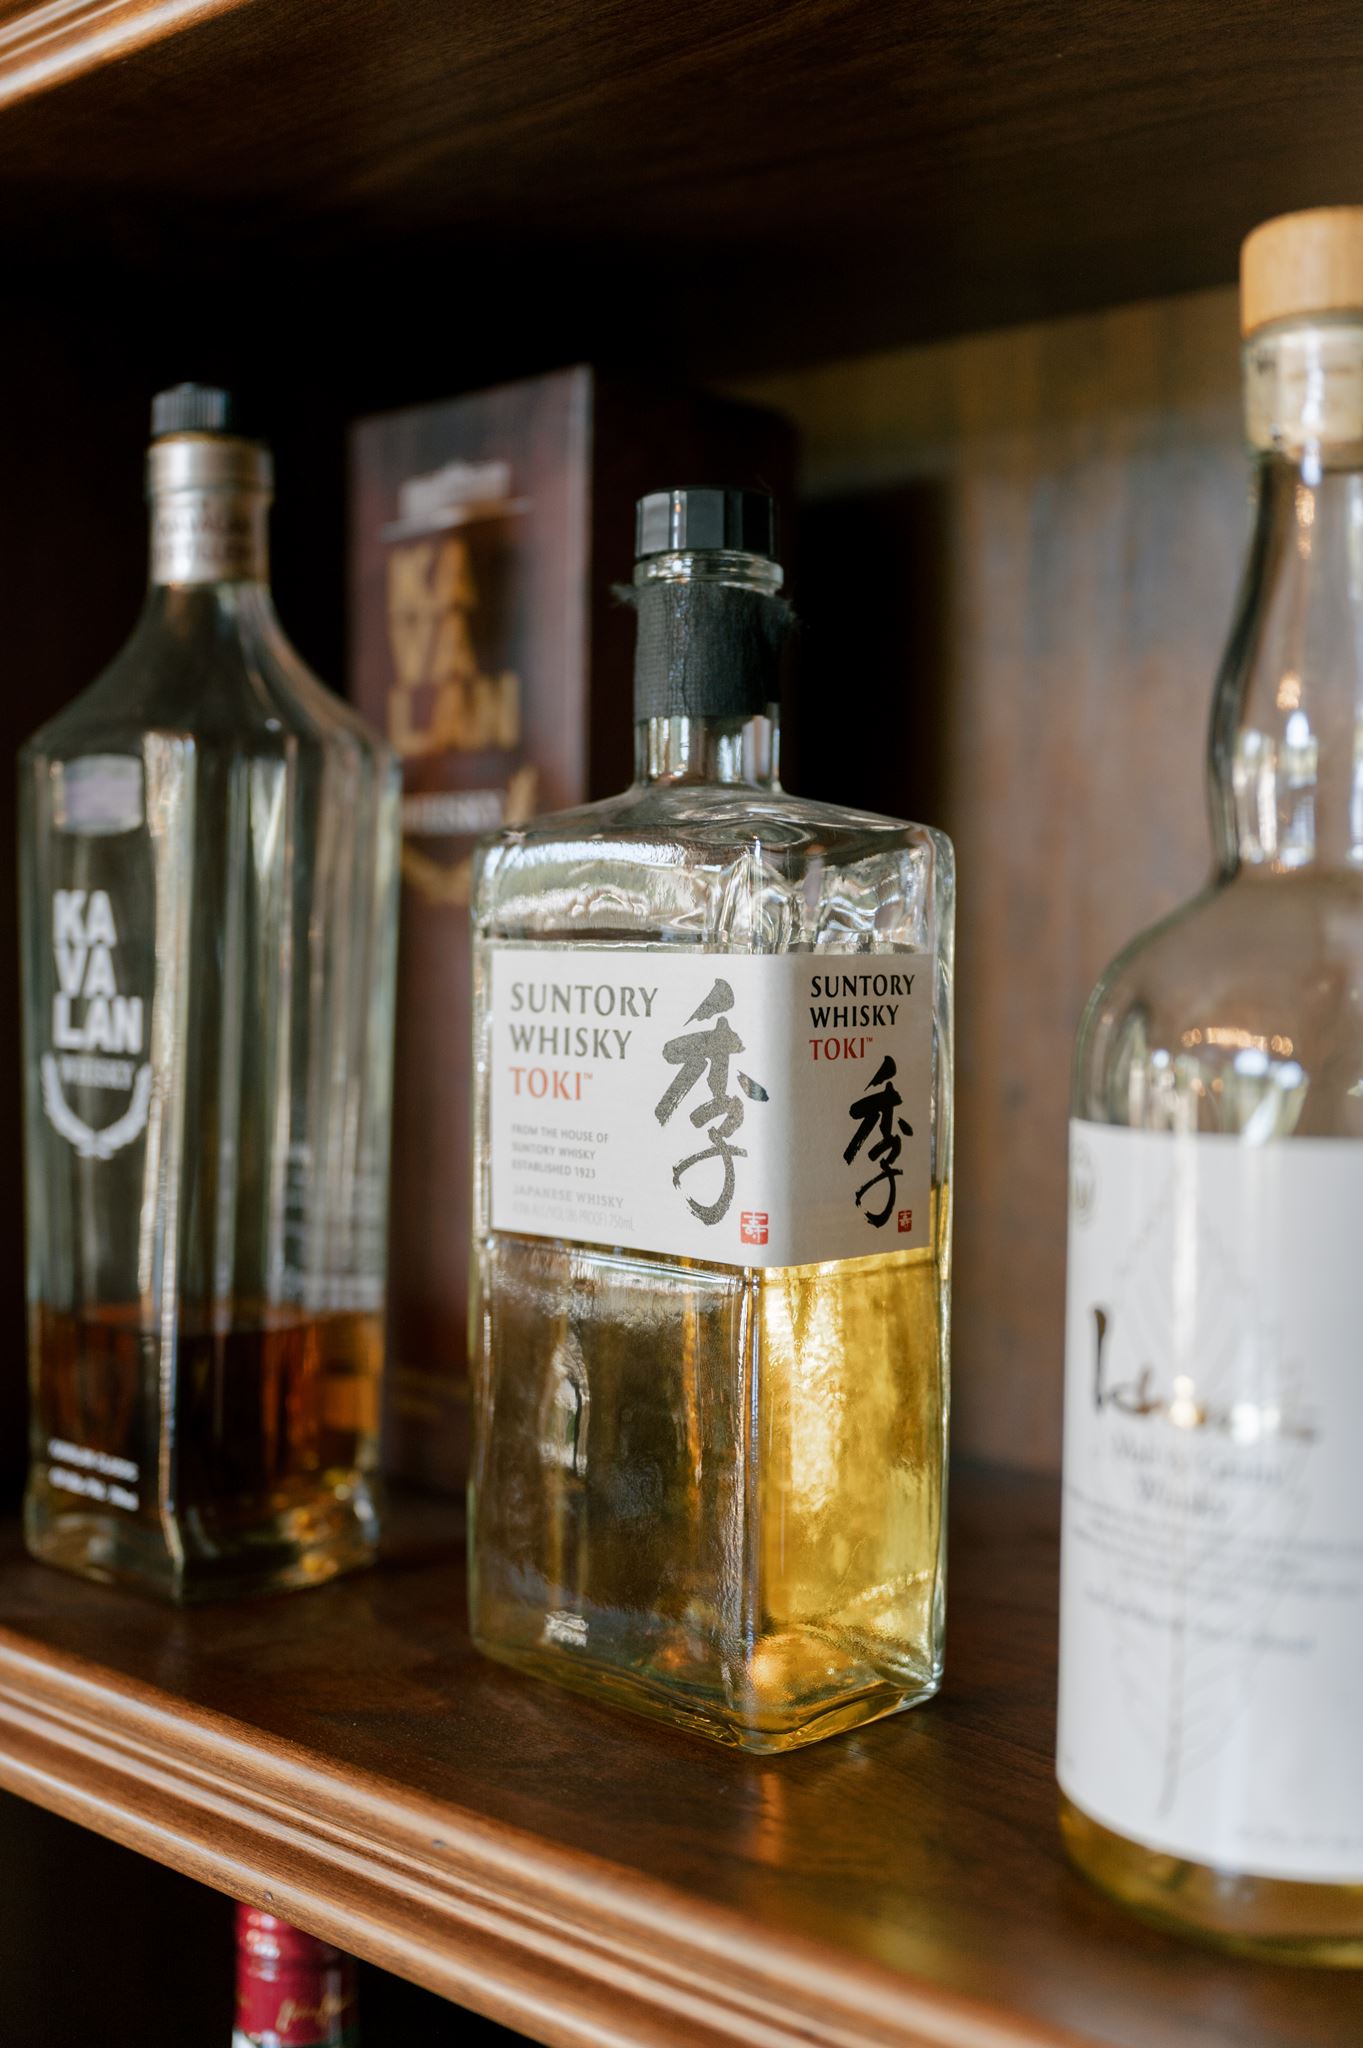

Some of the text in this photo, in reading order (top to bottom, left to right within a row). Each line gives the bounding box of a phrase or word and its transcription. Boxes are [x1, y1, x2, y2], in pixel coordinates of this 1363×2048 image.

[53, 888, 117, 948] KA
[54, 944, 117, 998] VA
[810, 974, 915, 998] SUNTORY
[510, 981, 659, 1018] SUNTORY
[809, 1004, 899, 1028] WHISKY
[52, 995, 143, 1055] LAN
[509, 1023, 633, 1060] WHISKY
[654, 978, 769, 1226] 季
[511, 1123, 609, 1144] FROM THE HOUSE OF
[511, 1141, 596, 1160] SUNTORY WHISKY
[843, 1055, 914, 1229] 季
[511, 1159, 596, 1179] ESTABLISHED 1923
[512, 1184, 624, 1209] JAPANESE WHISKY
